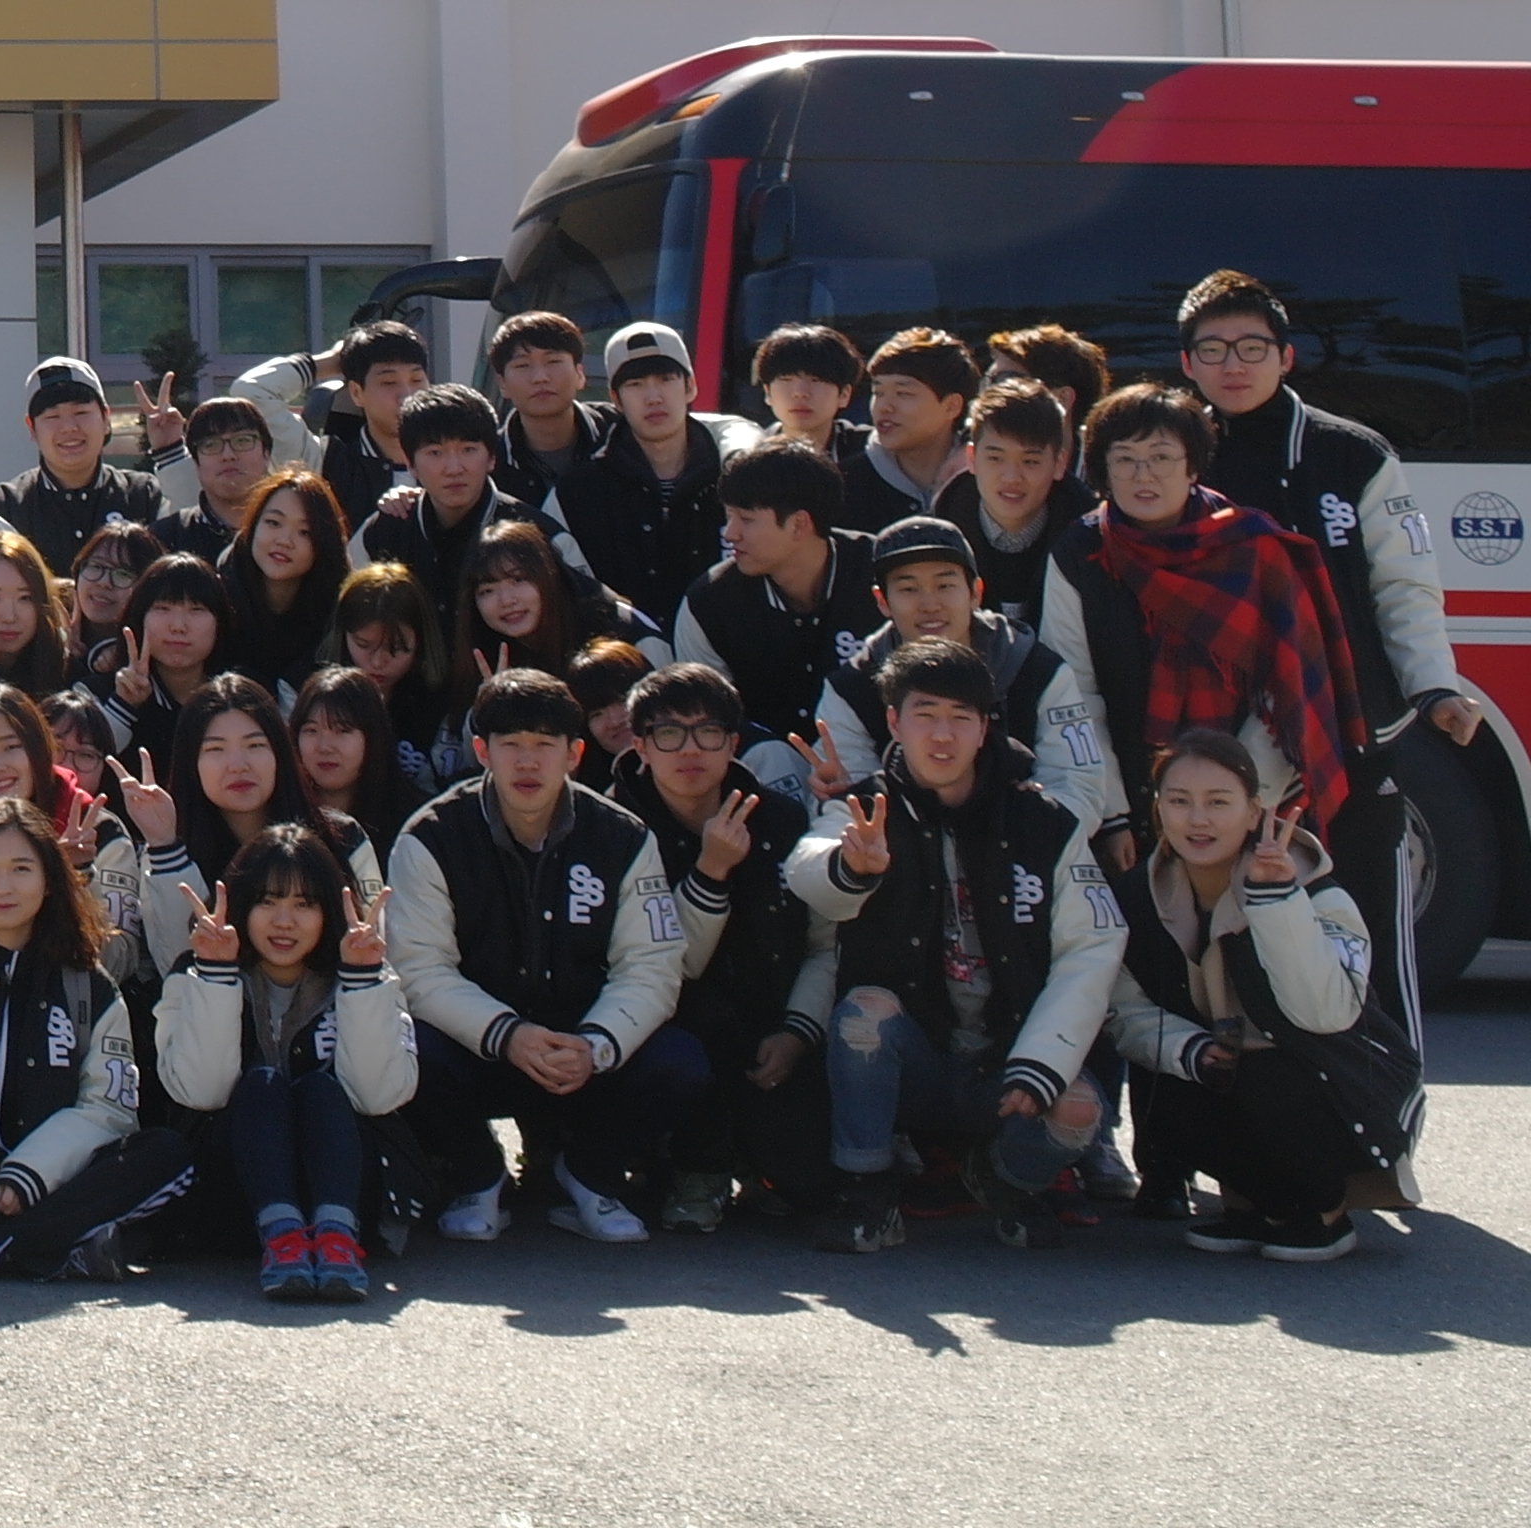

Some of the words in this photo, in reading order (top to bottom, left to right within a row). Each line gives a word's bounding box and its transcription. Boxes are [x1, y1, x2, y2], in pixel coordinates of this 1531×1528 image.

[1457, 519, 1516, 537] S.S.T
[1060, 722, 1102, 767] 11
[105, 890, 142, 940] 12
[643, 896, 683, 942] 12
[1083, 886, 1126, 929] 11
[104, 1058, 141, 1110] 13
